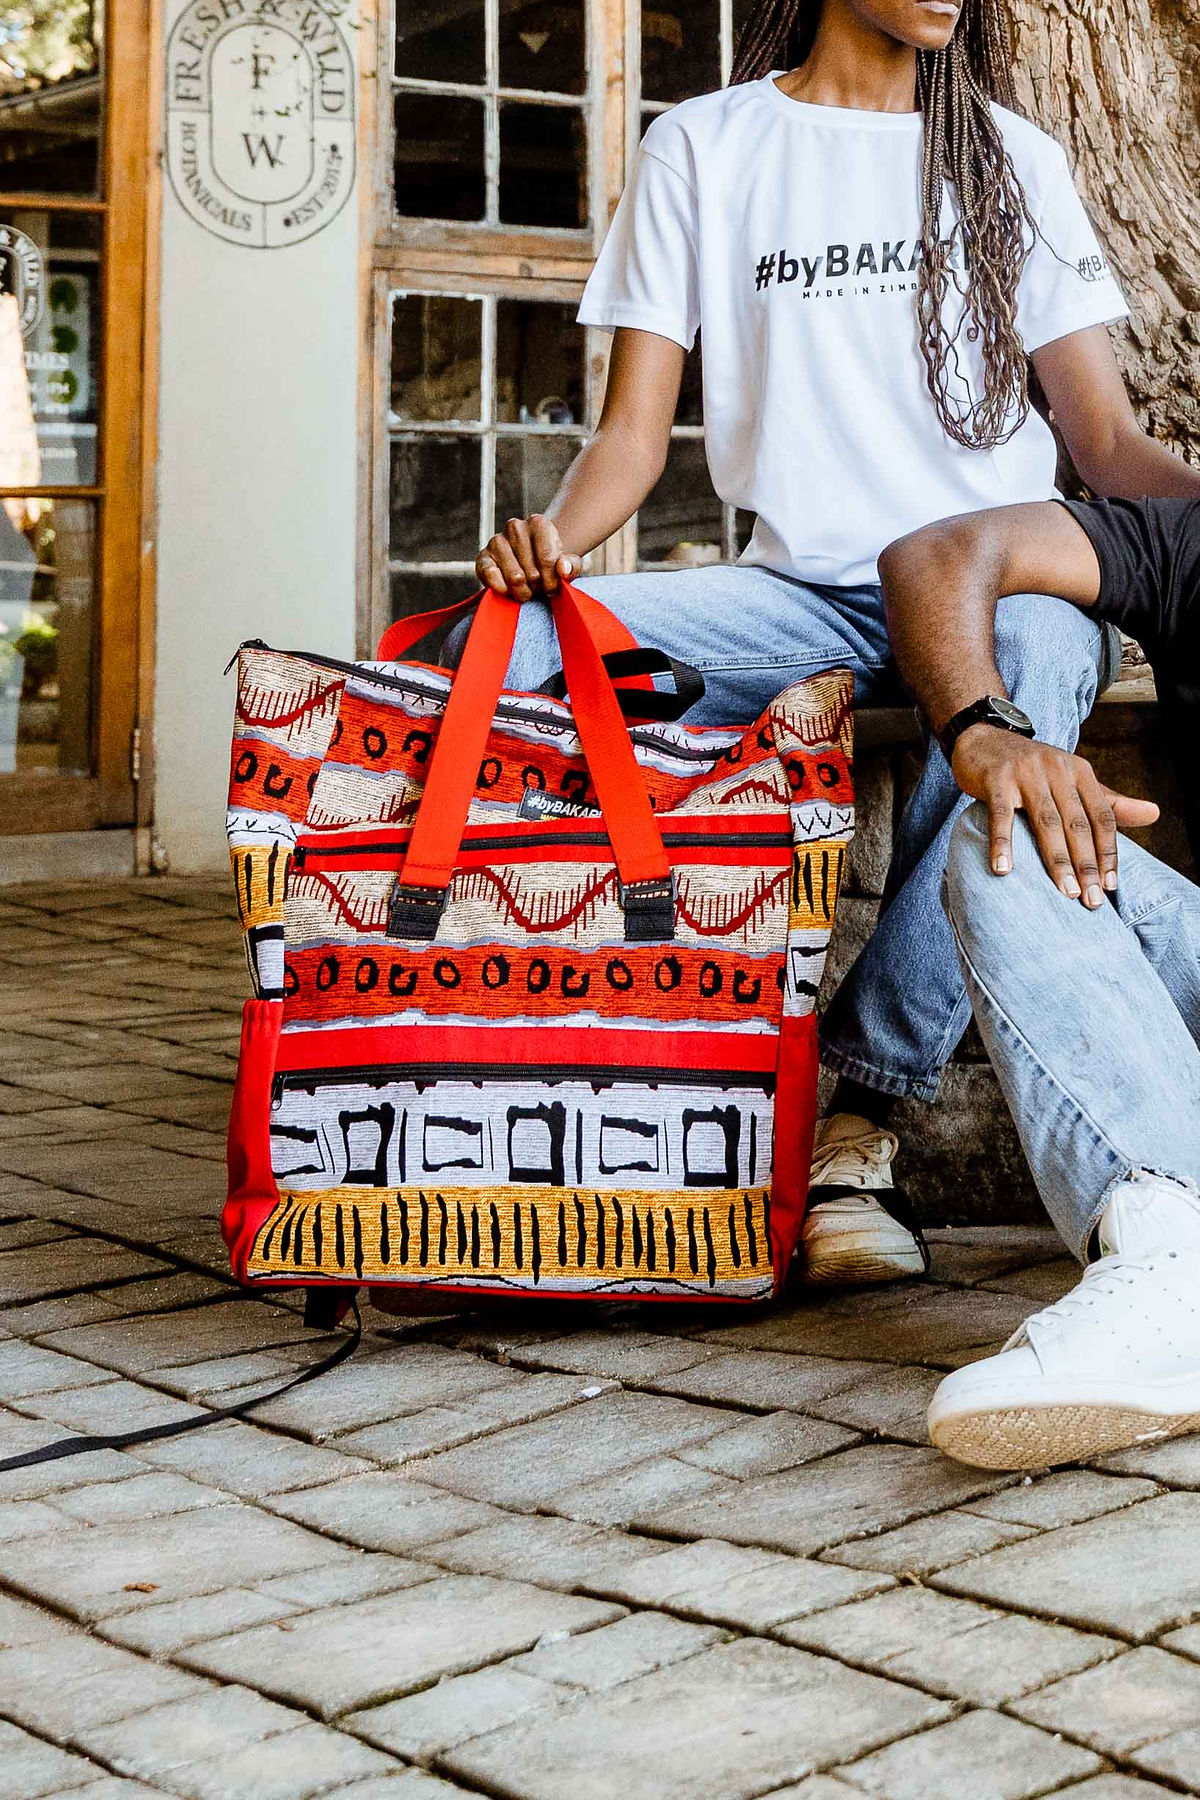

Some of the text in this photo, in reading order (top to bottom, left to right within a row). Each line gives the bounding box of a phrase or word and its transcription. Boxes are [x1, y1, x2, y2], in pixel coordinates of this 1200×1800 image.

[252, 53, 276, 89] F
[300, 8, 346, 113] WILD
[241, 132, 286, 169] W
[181, 120, 252, 232] BOTANICALS
[802, 282, 918, 300] MADE IN ZIMB
